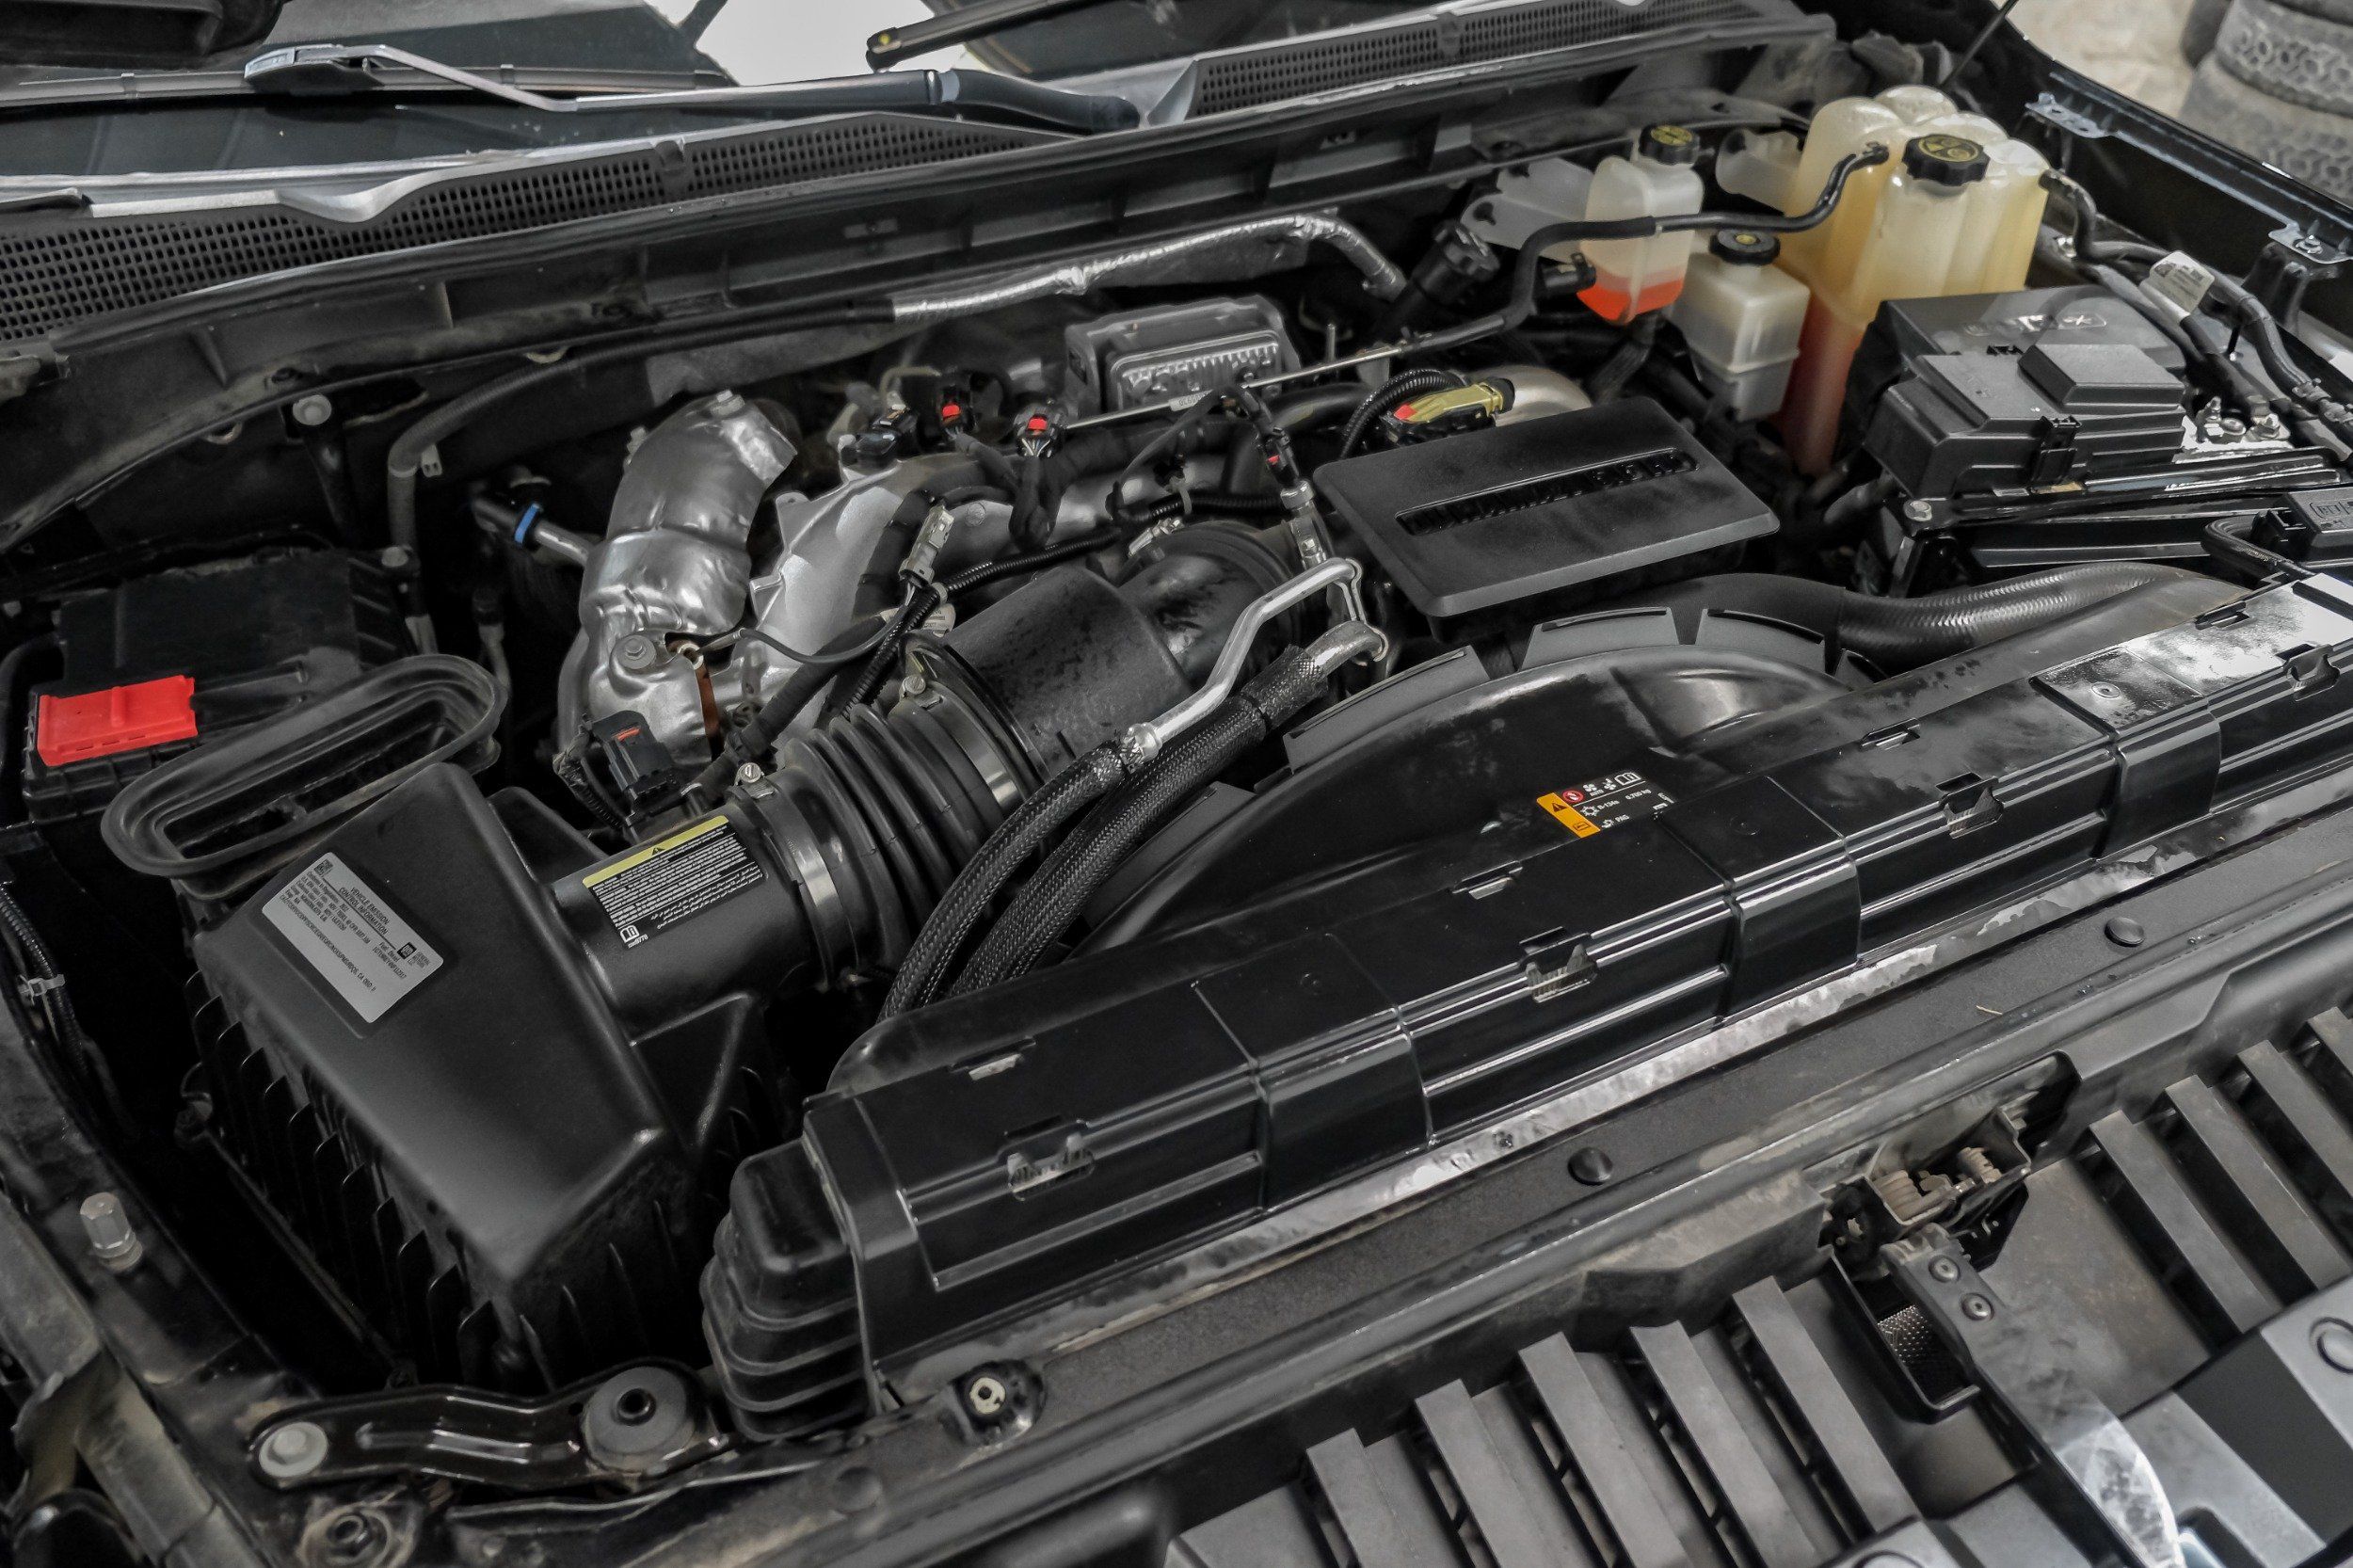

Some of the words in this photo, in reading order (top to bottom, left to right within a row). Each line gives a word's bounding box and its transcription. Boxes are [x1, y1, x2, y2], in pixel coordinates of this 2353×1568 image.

[337, 886, 360, 908] CONTROL
[356, 904, 389, 936] INFORMATION
[349, 886, 370, 906] VEHICLE
[366, 902, 391, 925] EMISSION
